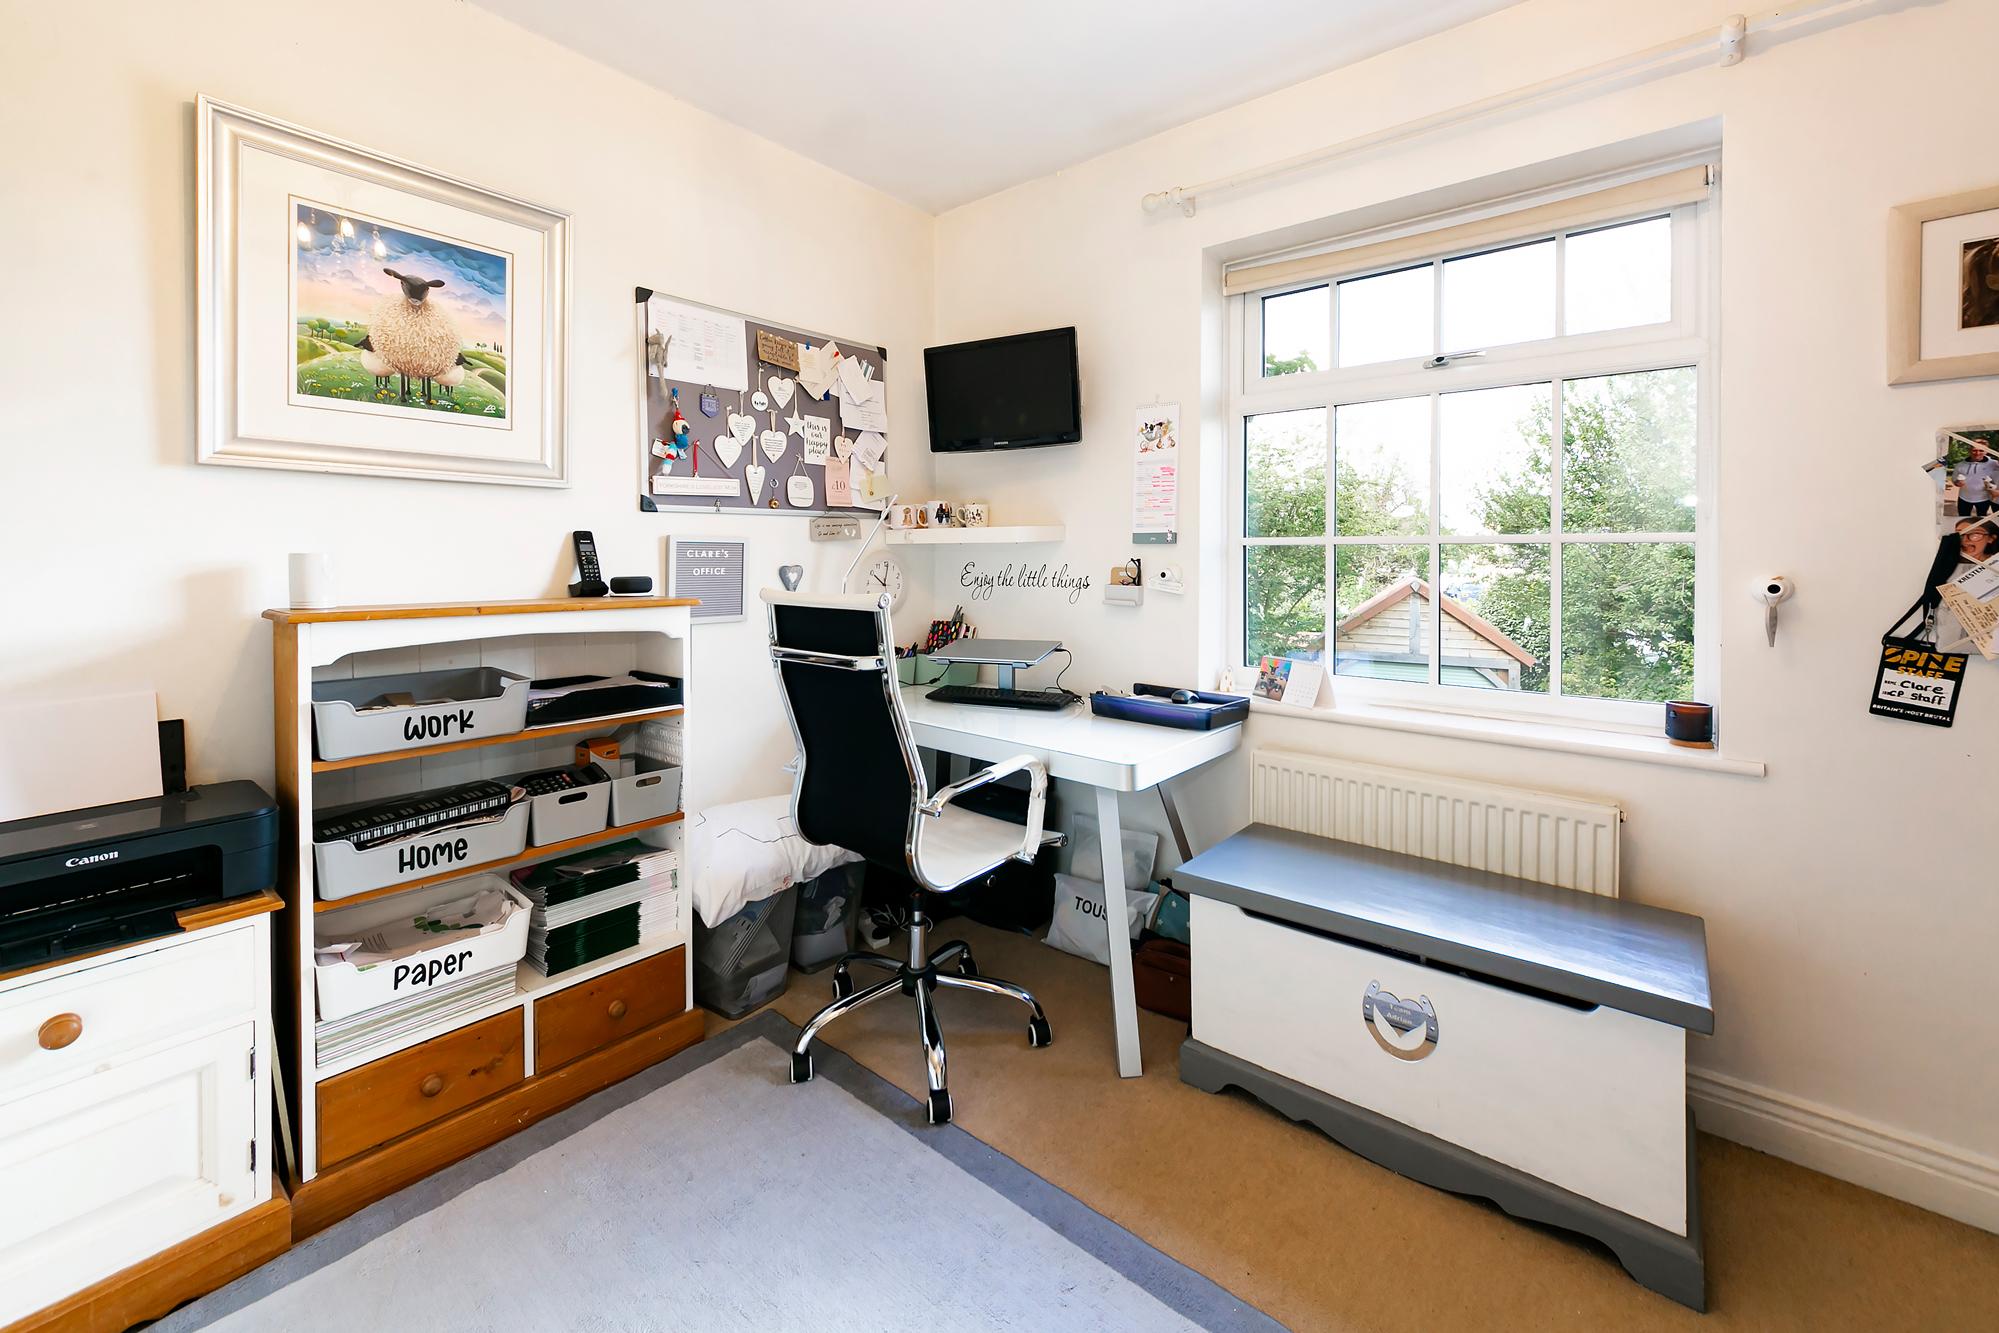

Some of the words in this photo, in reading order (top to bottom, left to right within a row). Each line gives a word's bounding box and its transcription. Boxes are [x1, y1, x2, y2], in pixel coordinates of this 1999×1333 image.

[806, 437, 828, 450] happy
[808, 445, 825, 456] place
[686, 549, 729, 558] CLARE'S
[692, 567, 726, 576] OFFICE
[960, 561, 994, 601] Enjoy
[997, 563, 1014, 587] the
[1017, 563, 1048, 588] little
[1051, 563, 1091, 605] things
[1884, 647, 1966, 673] SPINE
[1896, 666, 1945, 680] STAFF
[1900, 680, 1944, 695] Clare
[1872, 703, 1904, 714] BRITAIN'S
[1924, 712, 1951, 722] BRUTAL
[65, 851, 119, 868] Canon
